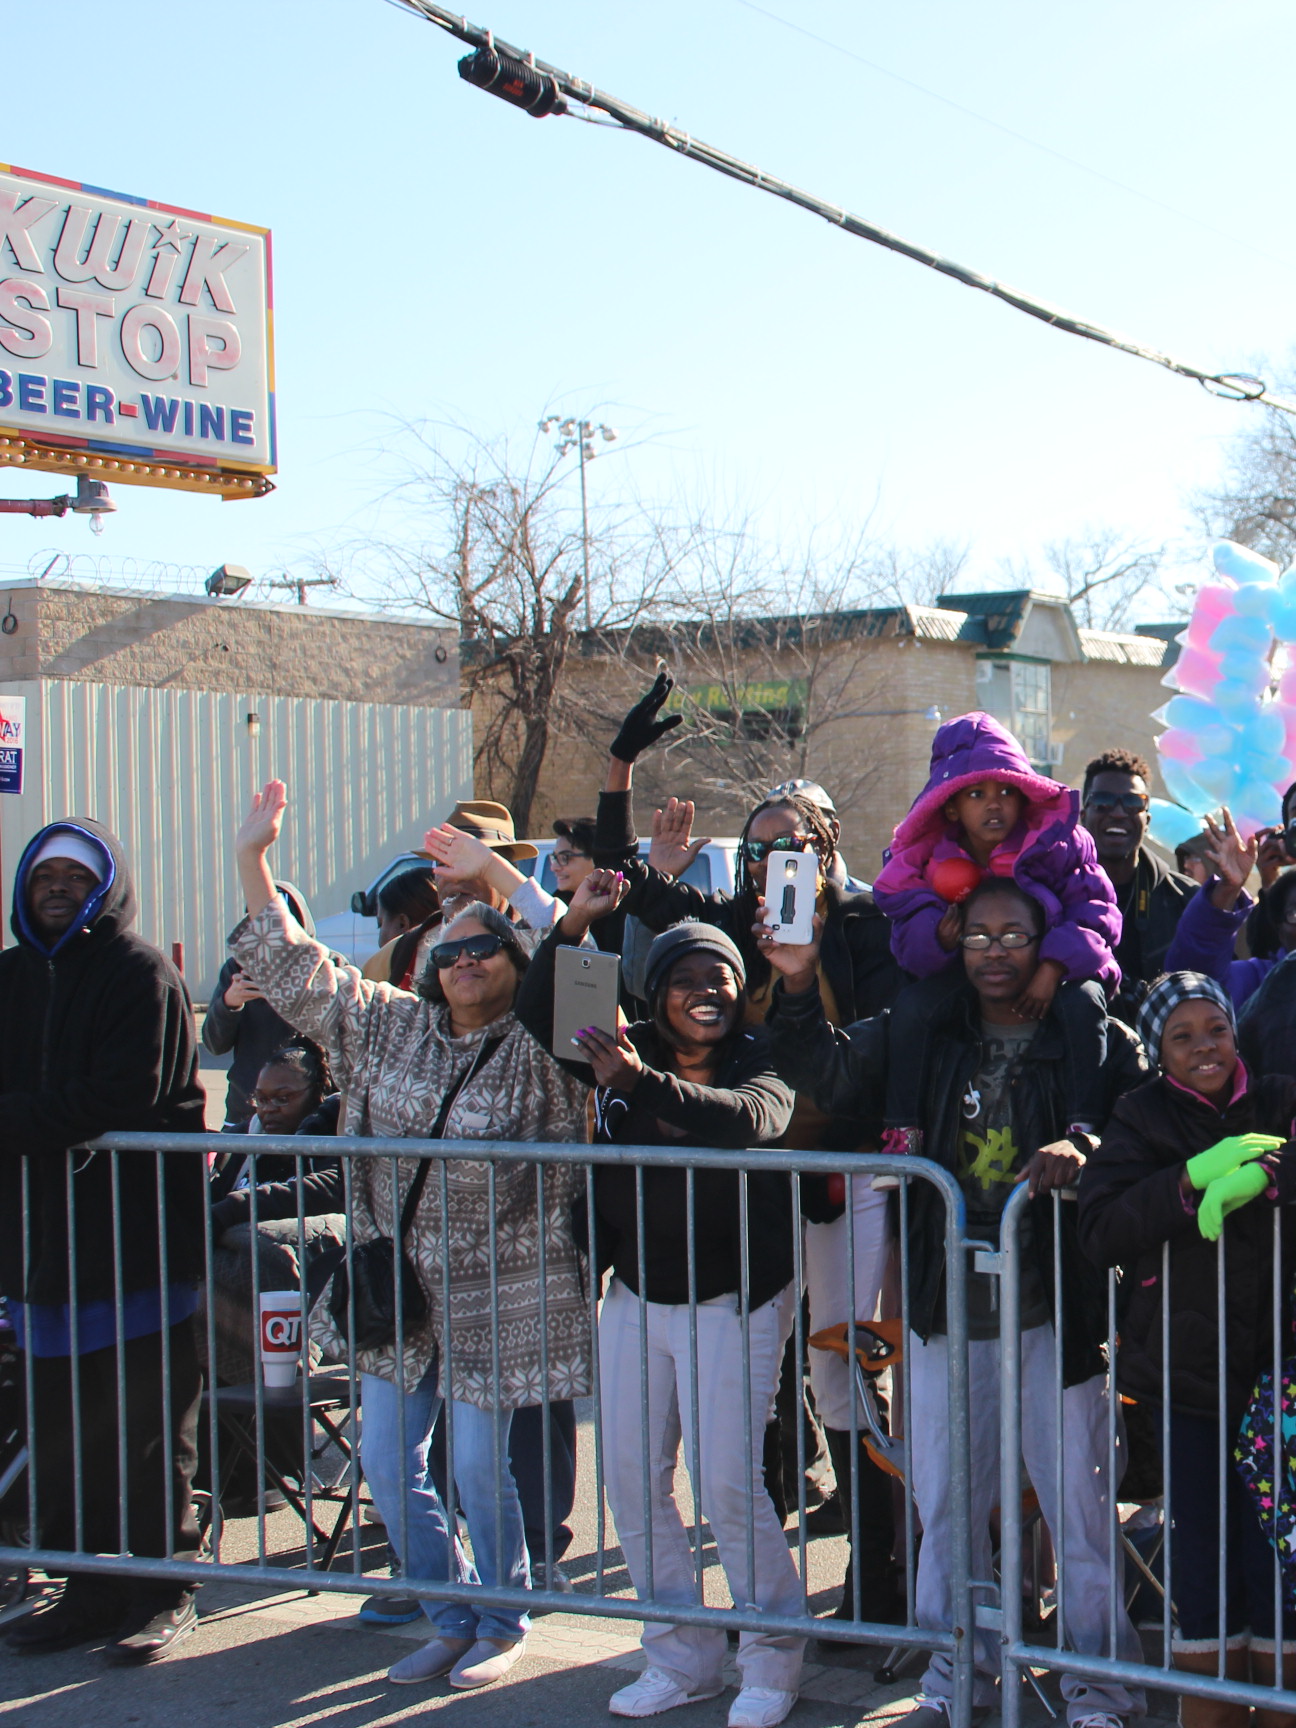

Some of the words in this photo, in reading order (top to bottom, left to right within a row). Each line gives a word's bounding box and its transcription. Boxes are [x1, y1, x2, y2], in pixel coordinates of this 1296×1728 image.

[0, 277, 242, 388] STOP
[707, 684, 789, 709] Reting
[266, 1316, 302, 1346] QT
